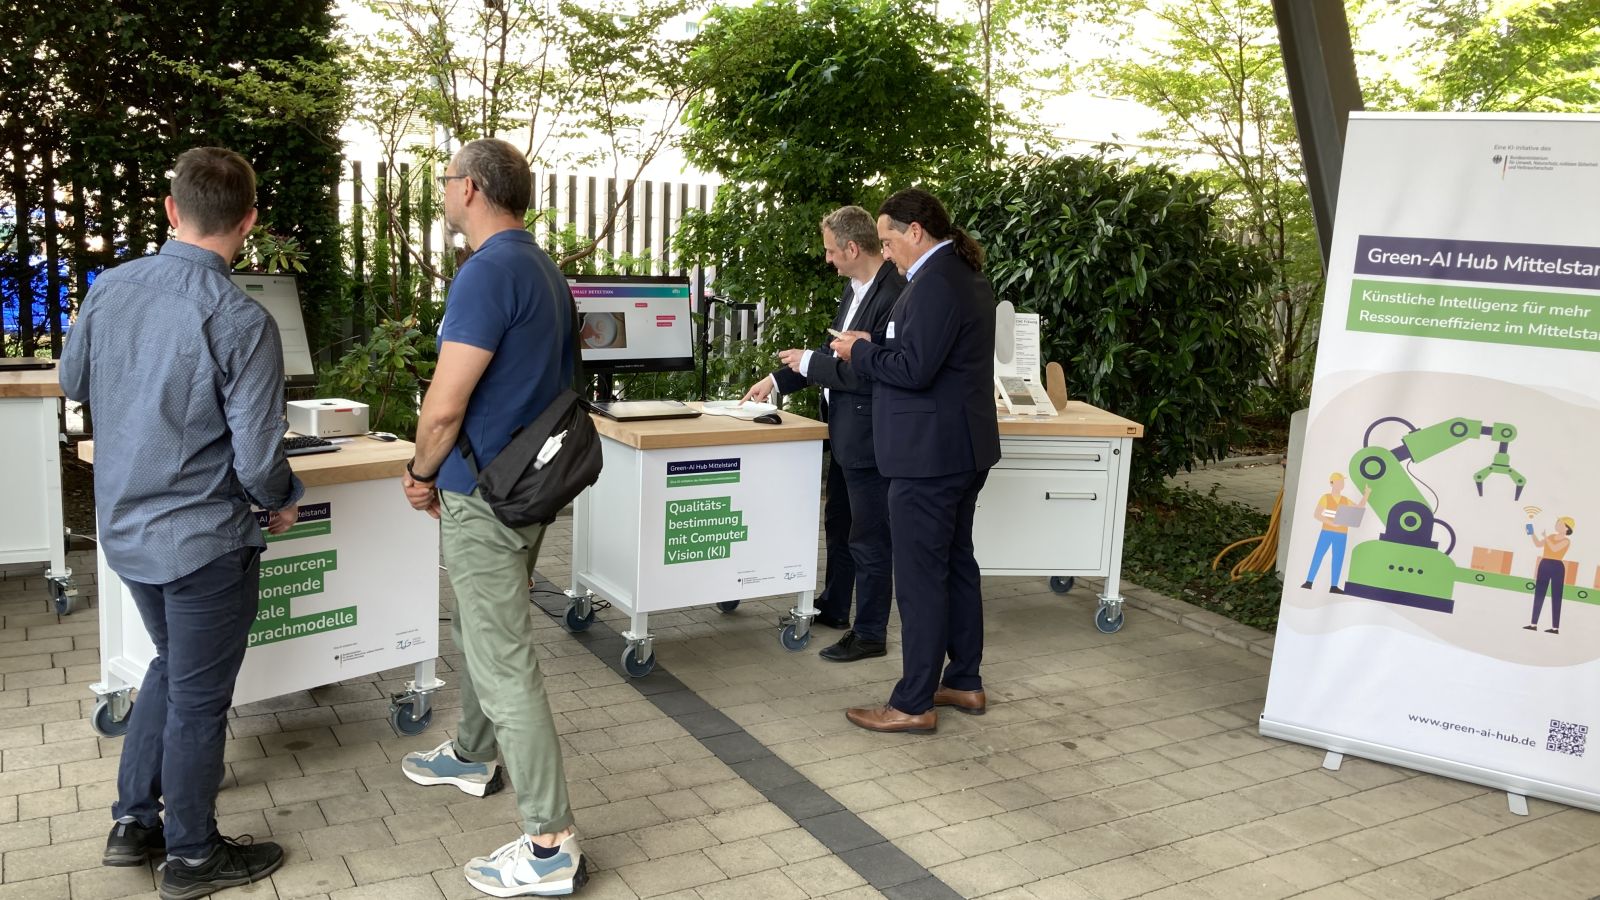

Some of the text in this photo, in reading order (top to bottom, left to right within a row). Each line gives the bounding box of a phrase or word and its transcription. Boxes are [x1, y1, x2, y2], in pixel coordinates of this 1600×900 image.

[1367, 247, 1452, 268] Green-AI
[1457, 252, 1498, 270] Hub
[1362, 289, 1592, 318] Künstliche Intelligenz für mehr
[1359, 310, 1600, 341] Ressourceneffizienz im Mittelsta
[708, 461, 738, 469] Mittelstand
[669, 500, 726, 515] Qualitäts-
[669, 515, 739, 530] bestimmung
[668, 530, 745, 546] mit Computer
[668, 545, 726, 561] Vision (KI)
[247, 611, 353, 647] prachmodelle
[1408, 713, 1536, 748] www.green-ai-hub.de
